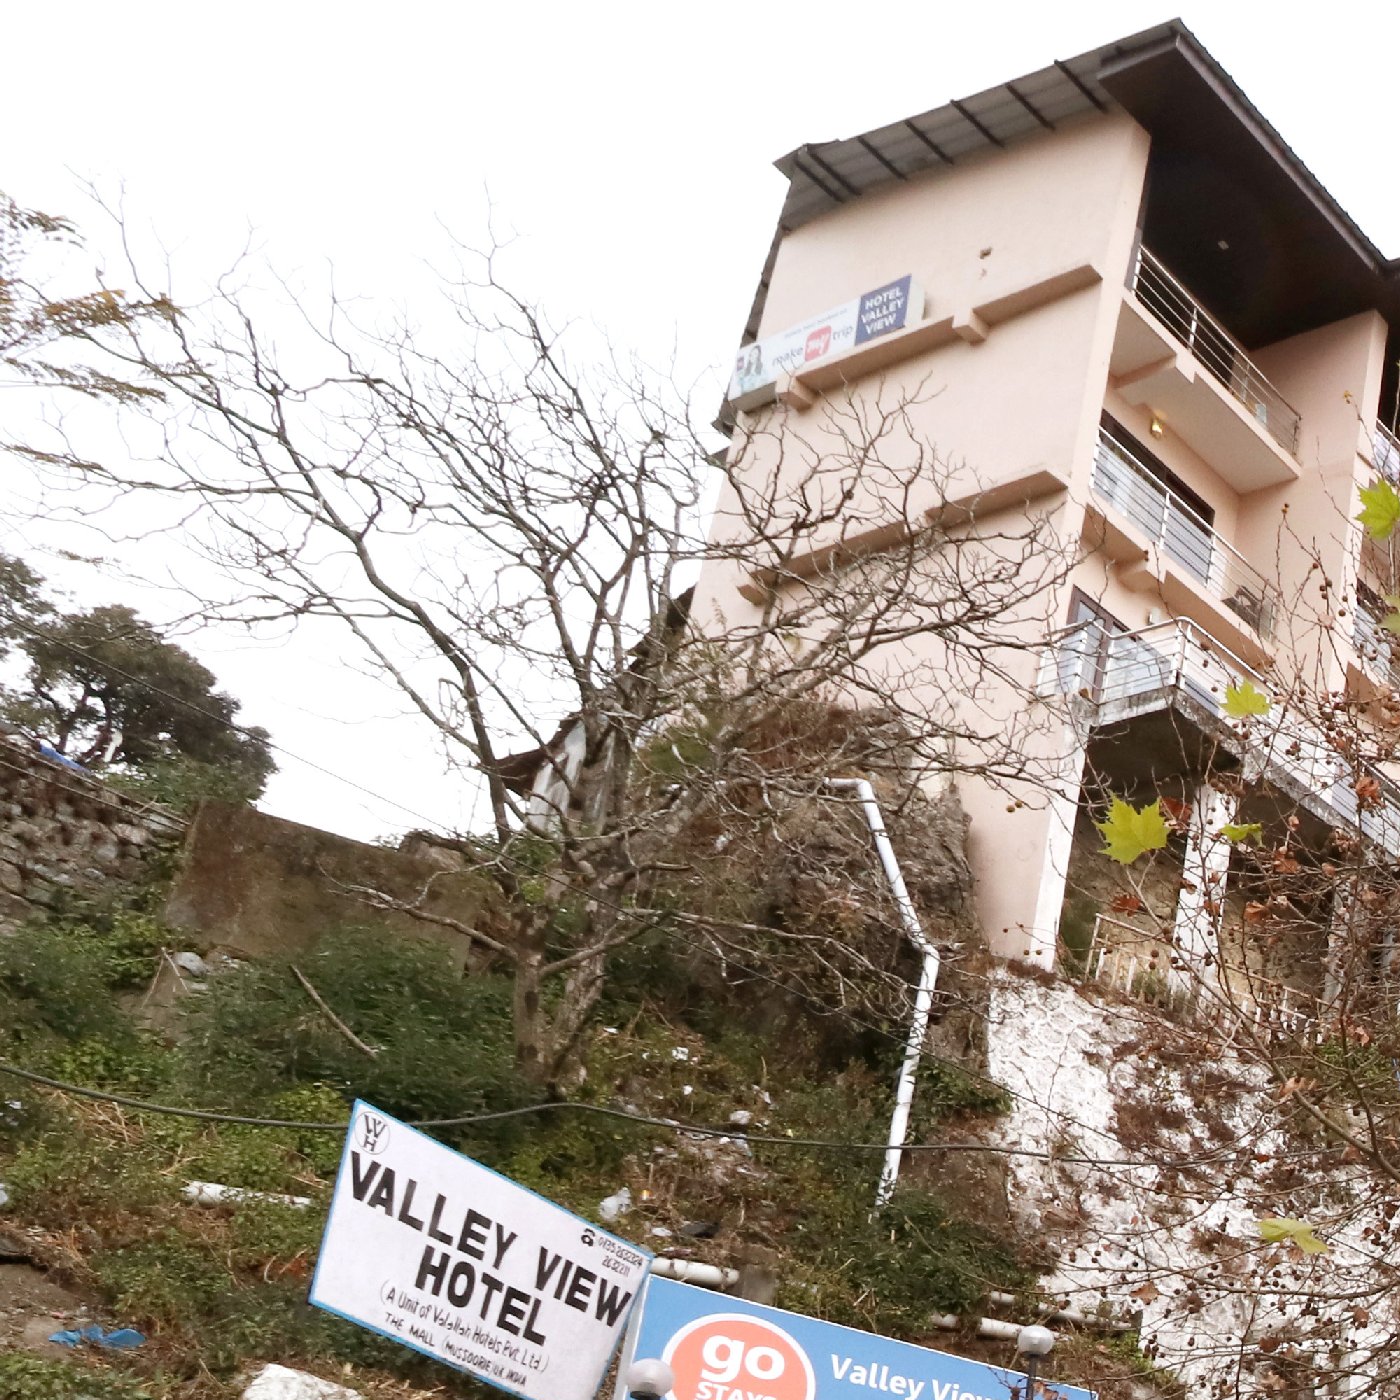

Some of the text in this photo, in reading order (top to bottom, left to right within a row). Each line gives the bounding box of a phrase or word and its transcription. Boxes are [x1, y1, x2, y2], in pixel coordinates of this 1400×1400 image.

[861, 298, 904, 323] VALLEY
[865, 286, 903, 310] HOTEL
[865, 313, 897, 335] VIEW
[351, 1151, 633, 1328] VALLEY VIEW
[415, 1246, 546, 1346] HOTEL
[385, 1311, 405, 1331] THE
[409, 1324, 435, 1347] MALL
[398, 1290, 420, 1314] Unit
[419, 1304, 432, 1319] of
[472, 1325, 503, 1354] Hotels
[702, 1335, 786, 1383] go
